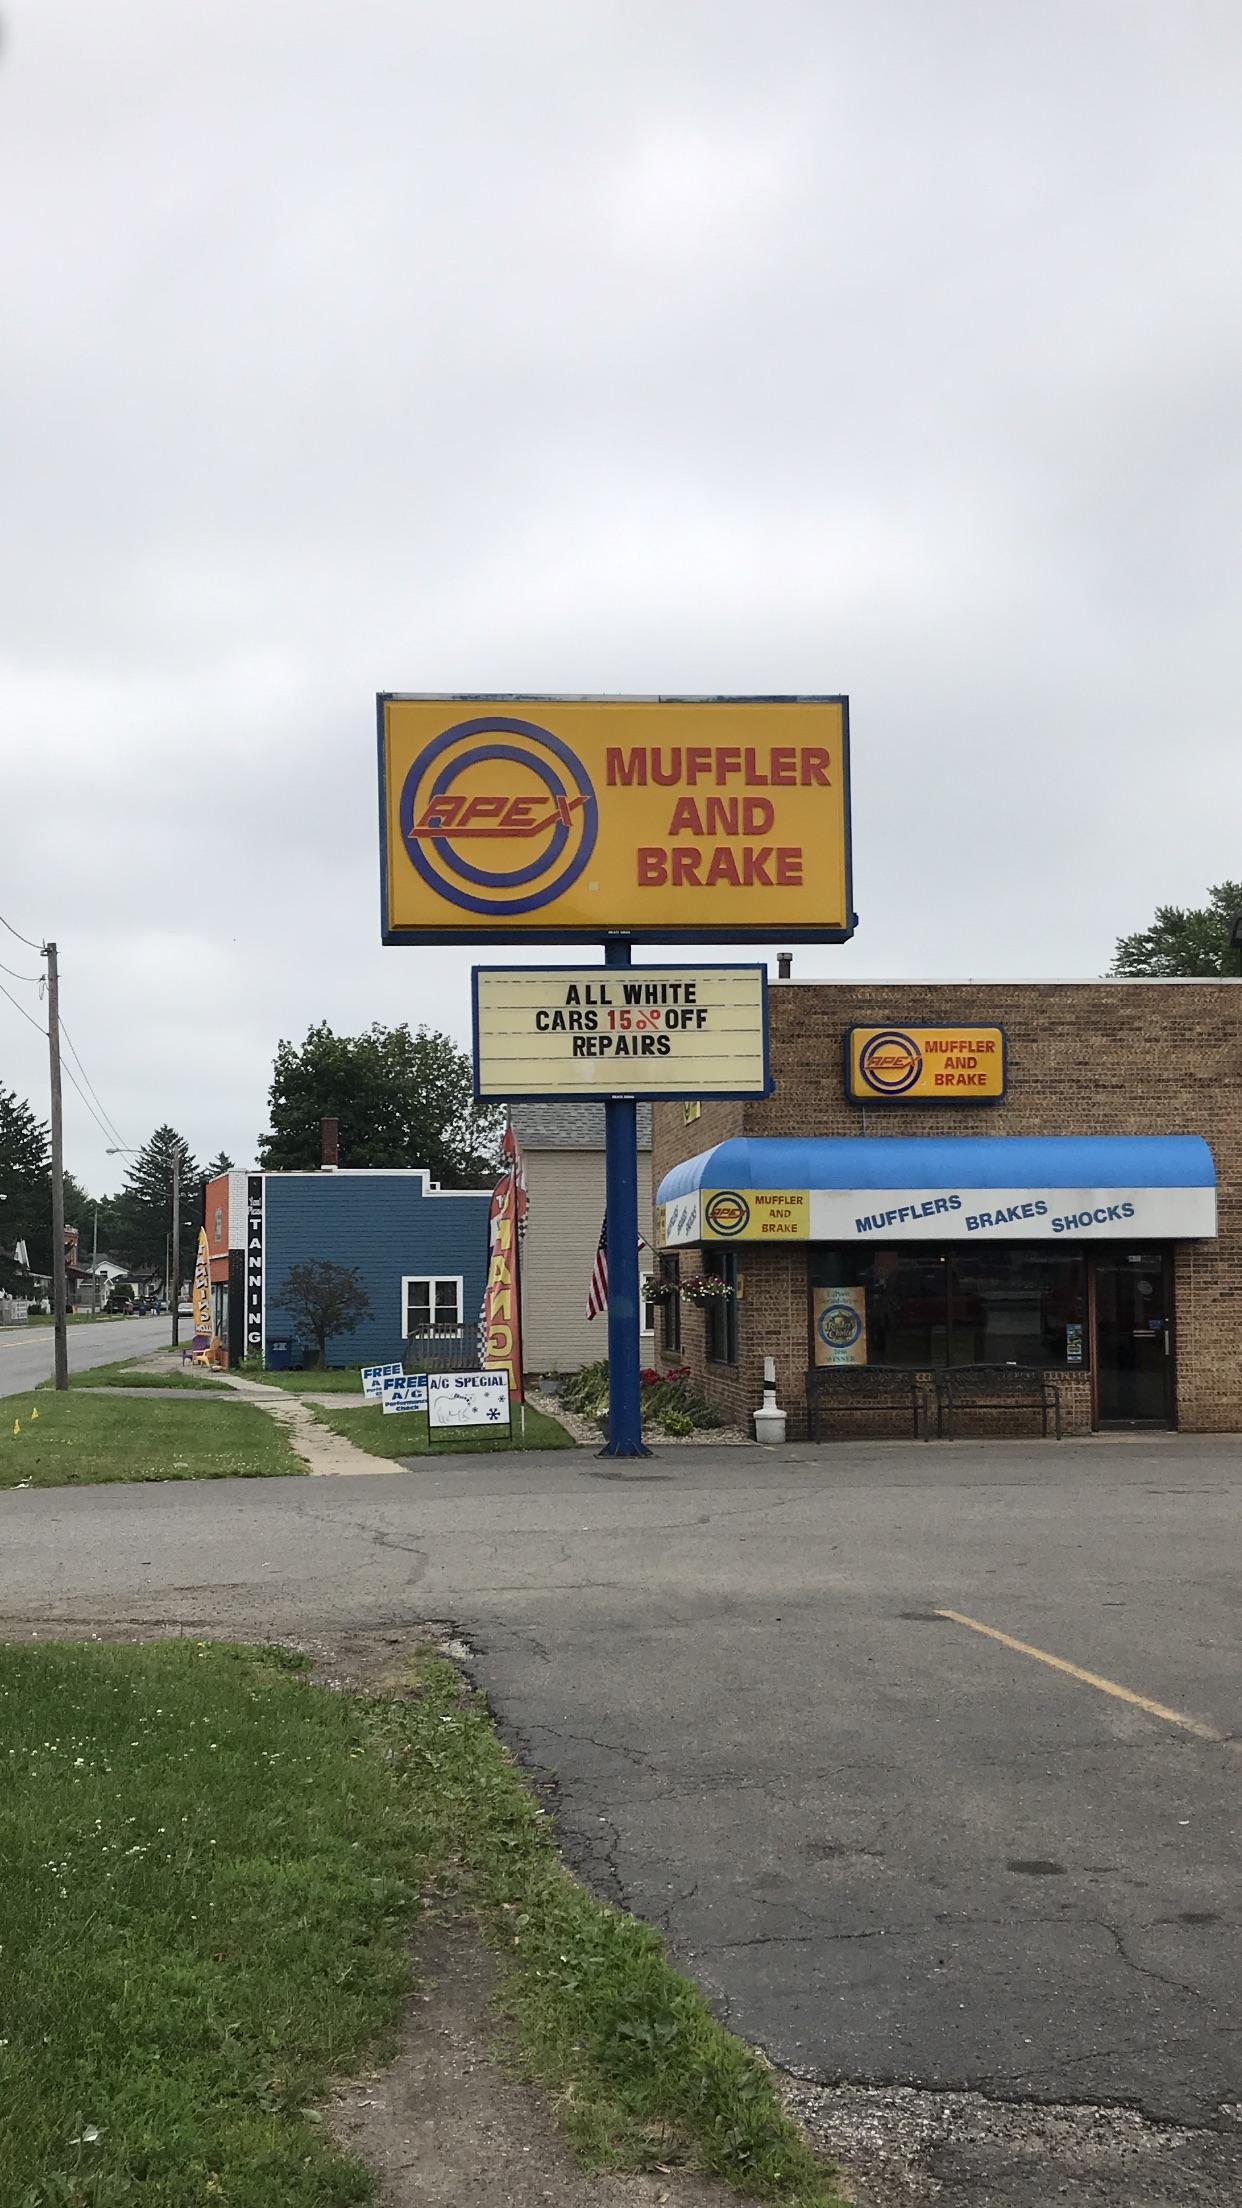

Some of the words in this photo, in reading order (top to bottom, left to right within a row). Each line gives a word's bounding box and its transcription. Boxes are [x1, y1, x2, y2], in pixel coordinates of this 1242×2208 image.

[606, 747, 831, 786] MUFFLER
[408, 795, 591, 837] APEX
[668, 797, 775, 835] AND
[637, 847, 803, 886] BRAKE
[565, 984, 613, 1005] ALL
[622, 983, 697, 1005] WHITE
[535, 1010, 598, 1031] CARS
[607, 1009, 661, 1030] 15%
[664, 1008, 708, 1029] OFF
[572, 1035, 671, 1057] REPAIRS
[924, 1040, 996, 1053] MUFFLER
[864, 1055, 922, 1070] APEX
[944, 1056, 978, 1069] AND
[934, 1073, 987, 1086] BRAKE
[755, 1196, 803, 1205] MUFFLER
[769, 1209, 791, 1218] AND
[855, 1195, 962, 1233] MUFFLERS
[965, 1200, 1048, 1231] BRAKES
[1051, 1202, 1135, 1233] SHOCKS
[762, 1224, 798, 1233] BRAKE
[248, 1219, 261, 1343] TANNING
[364, 1365, 401, 1379] FREE
[384, 1376, 427, 1390] FREE
[430, 1376, 450, 1389] A/C
[455, 1376, 506, 1387] SPECIAL
[392, 1389, 423, 1400] A/C
